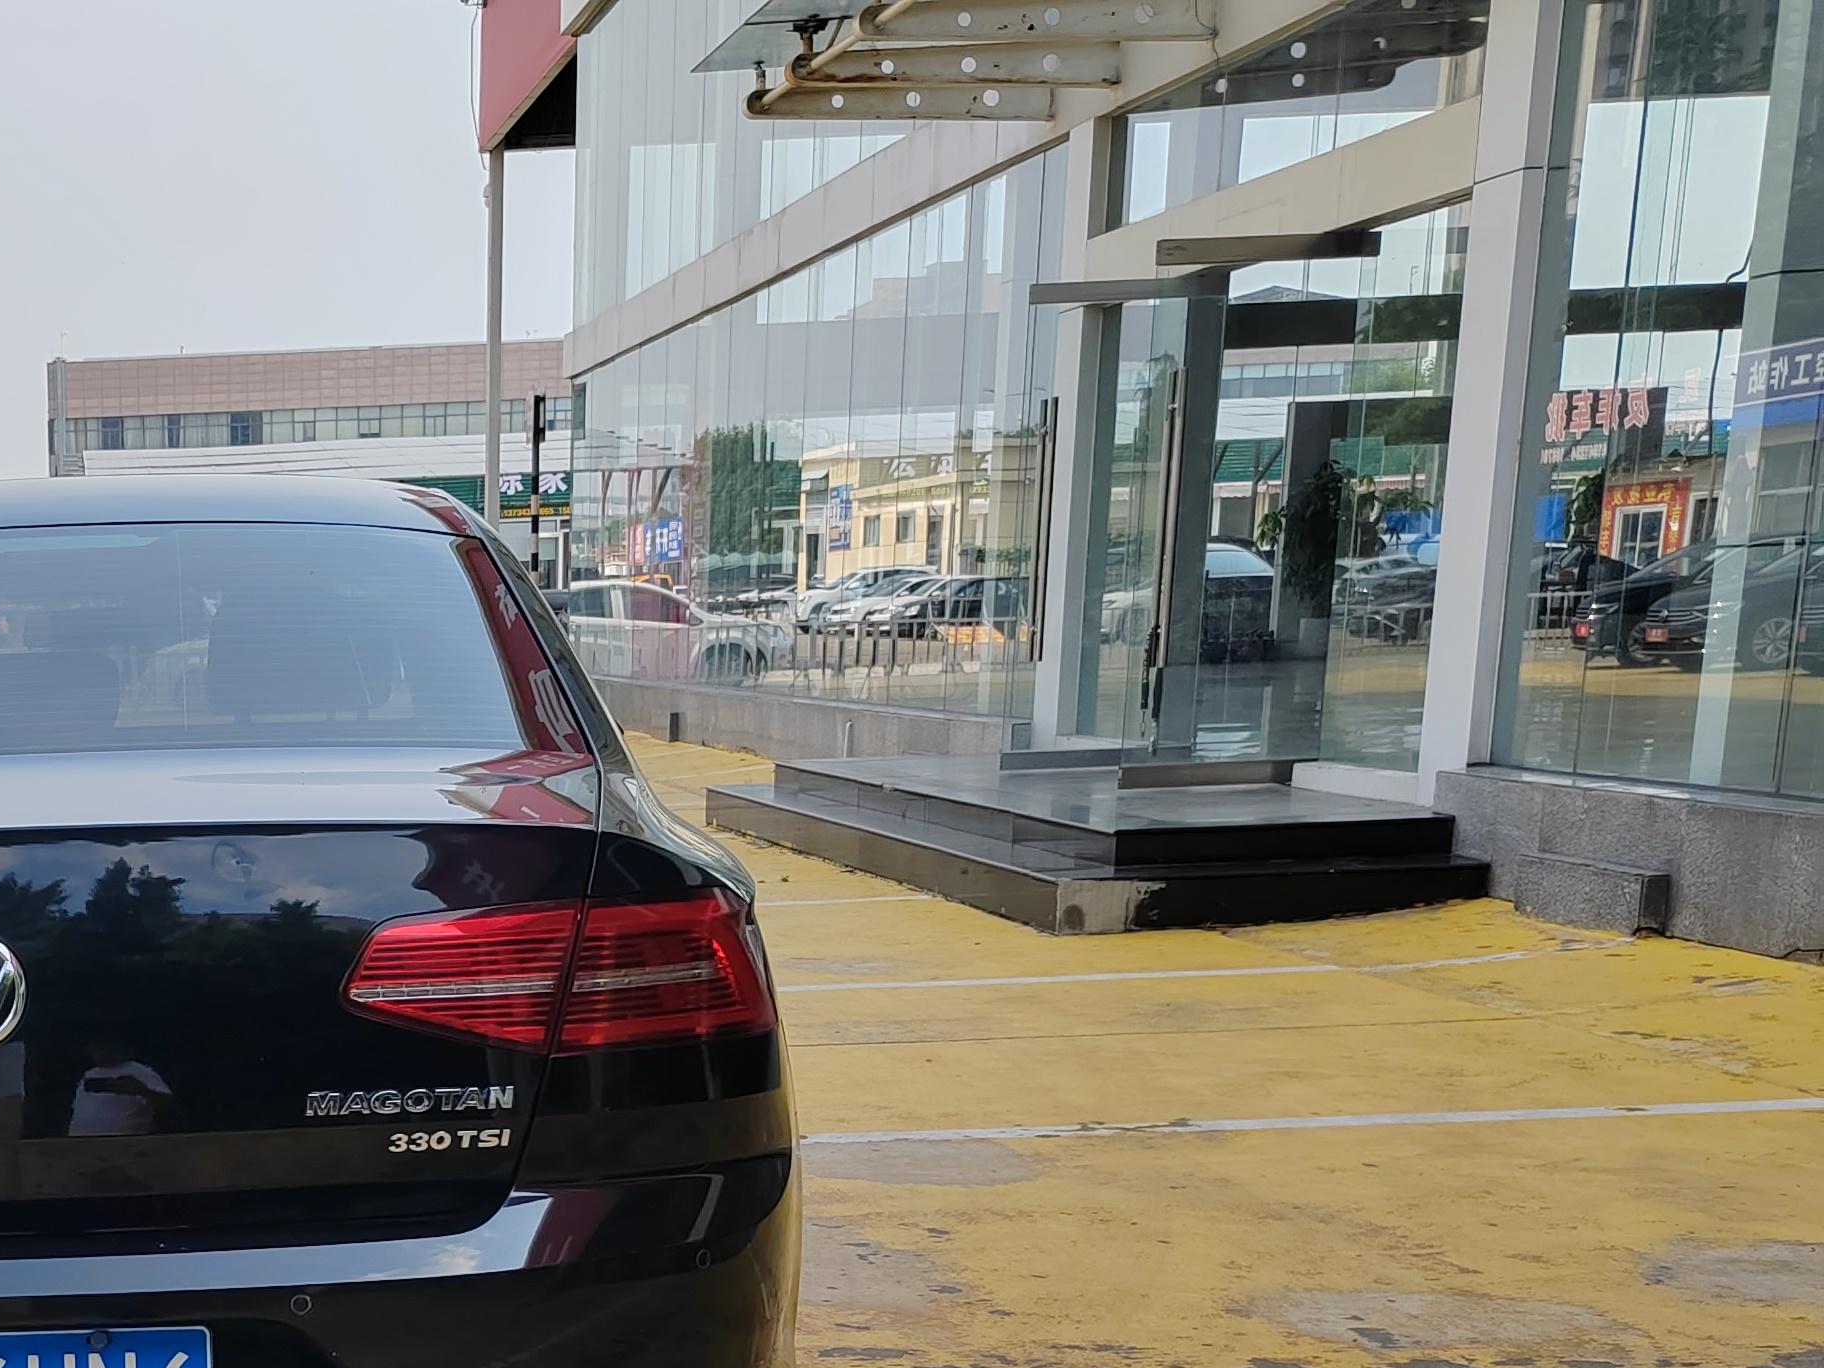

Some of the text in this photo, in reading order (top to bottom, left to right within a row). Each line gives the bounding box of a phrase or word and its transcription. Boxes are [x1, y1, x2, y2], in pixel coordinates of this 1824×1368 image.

[305, 1085, 515, 1117] MAGOTAN
[388, 1128, 511, 1152] 330 TSI
